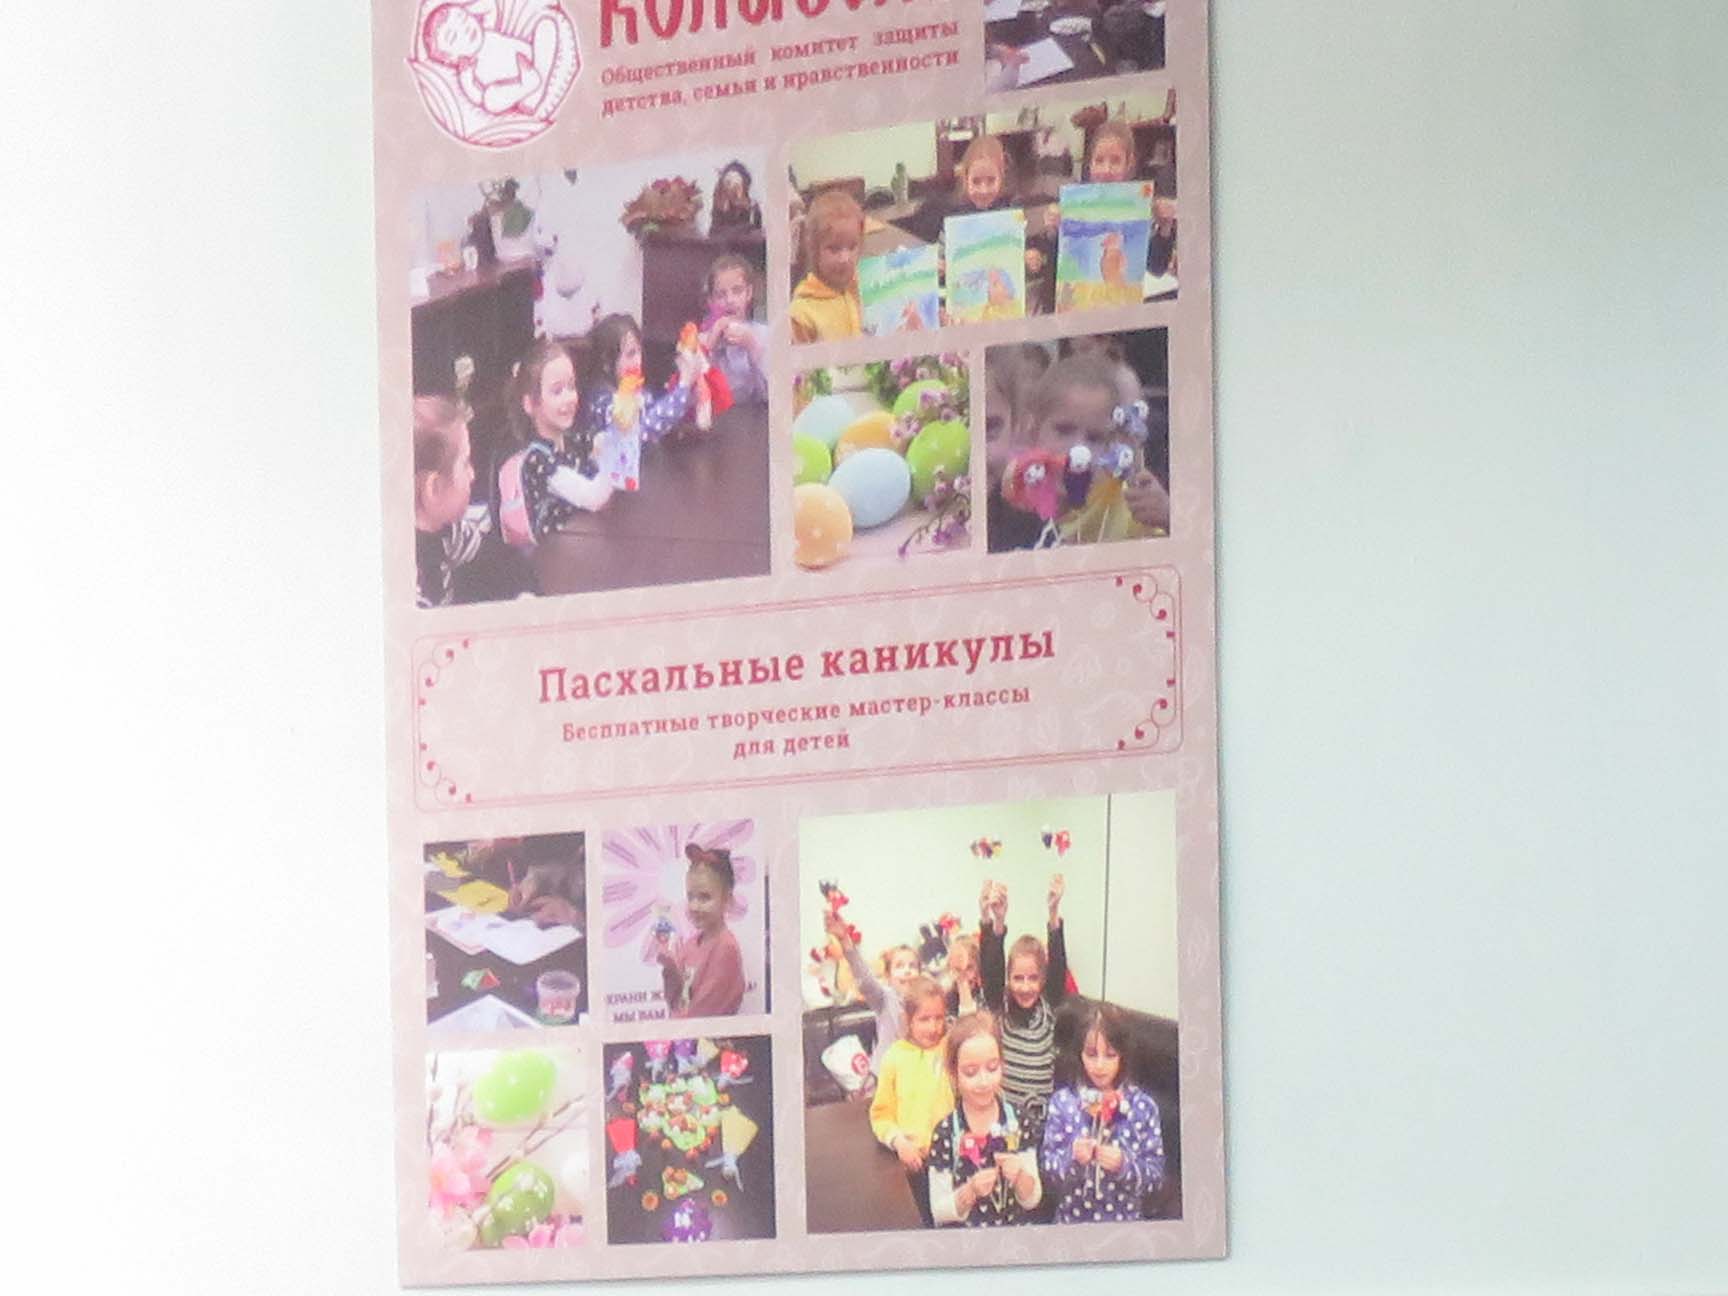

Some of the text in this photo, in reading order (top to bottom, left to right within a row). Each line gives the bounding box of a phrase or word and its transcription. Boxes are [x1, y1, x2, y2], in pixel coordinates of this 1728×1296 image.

[601, 49, 756, 86] Общественный
[771, 34, 859, 62] комитет
[873, 21, 959, 48] защиты
[693, 80, 758, 101] семьи
[764, 76, 777, 92] и
[783, 49, 959, 92] нравственности
[538, 629, 1056, 704] Пасхальные каникулы
[561, 685, 1031, 743] Бесплатные творческие мастер-классы
[733, 728, 851, 759] для детей
